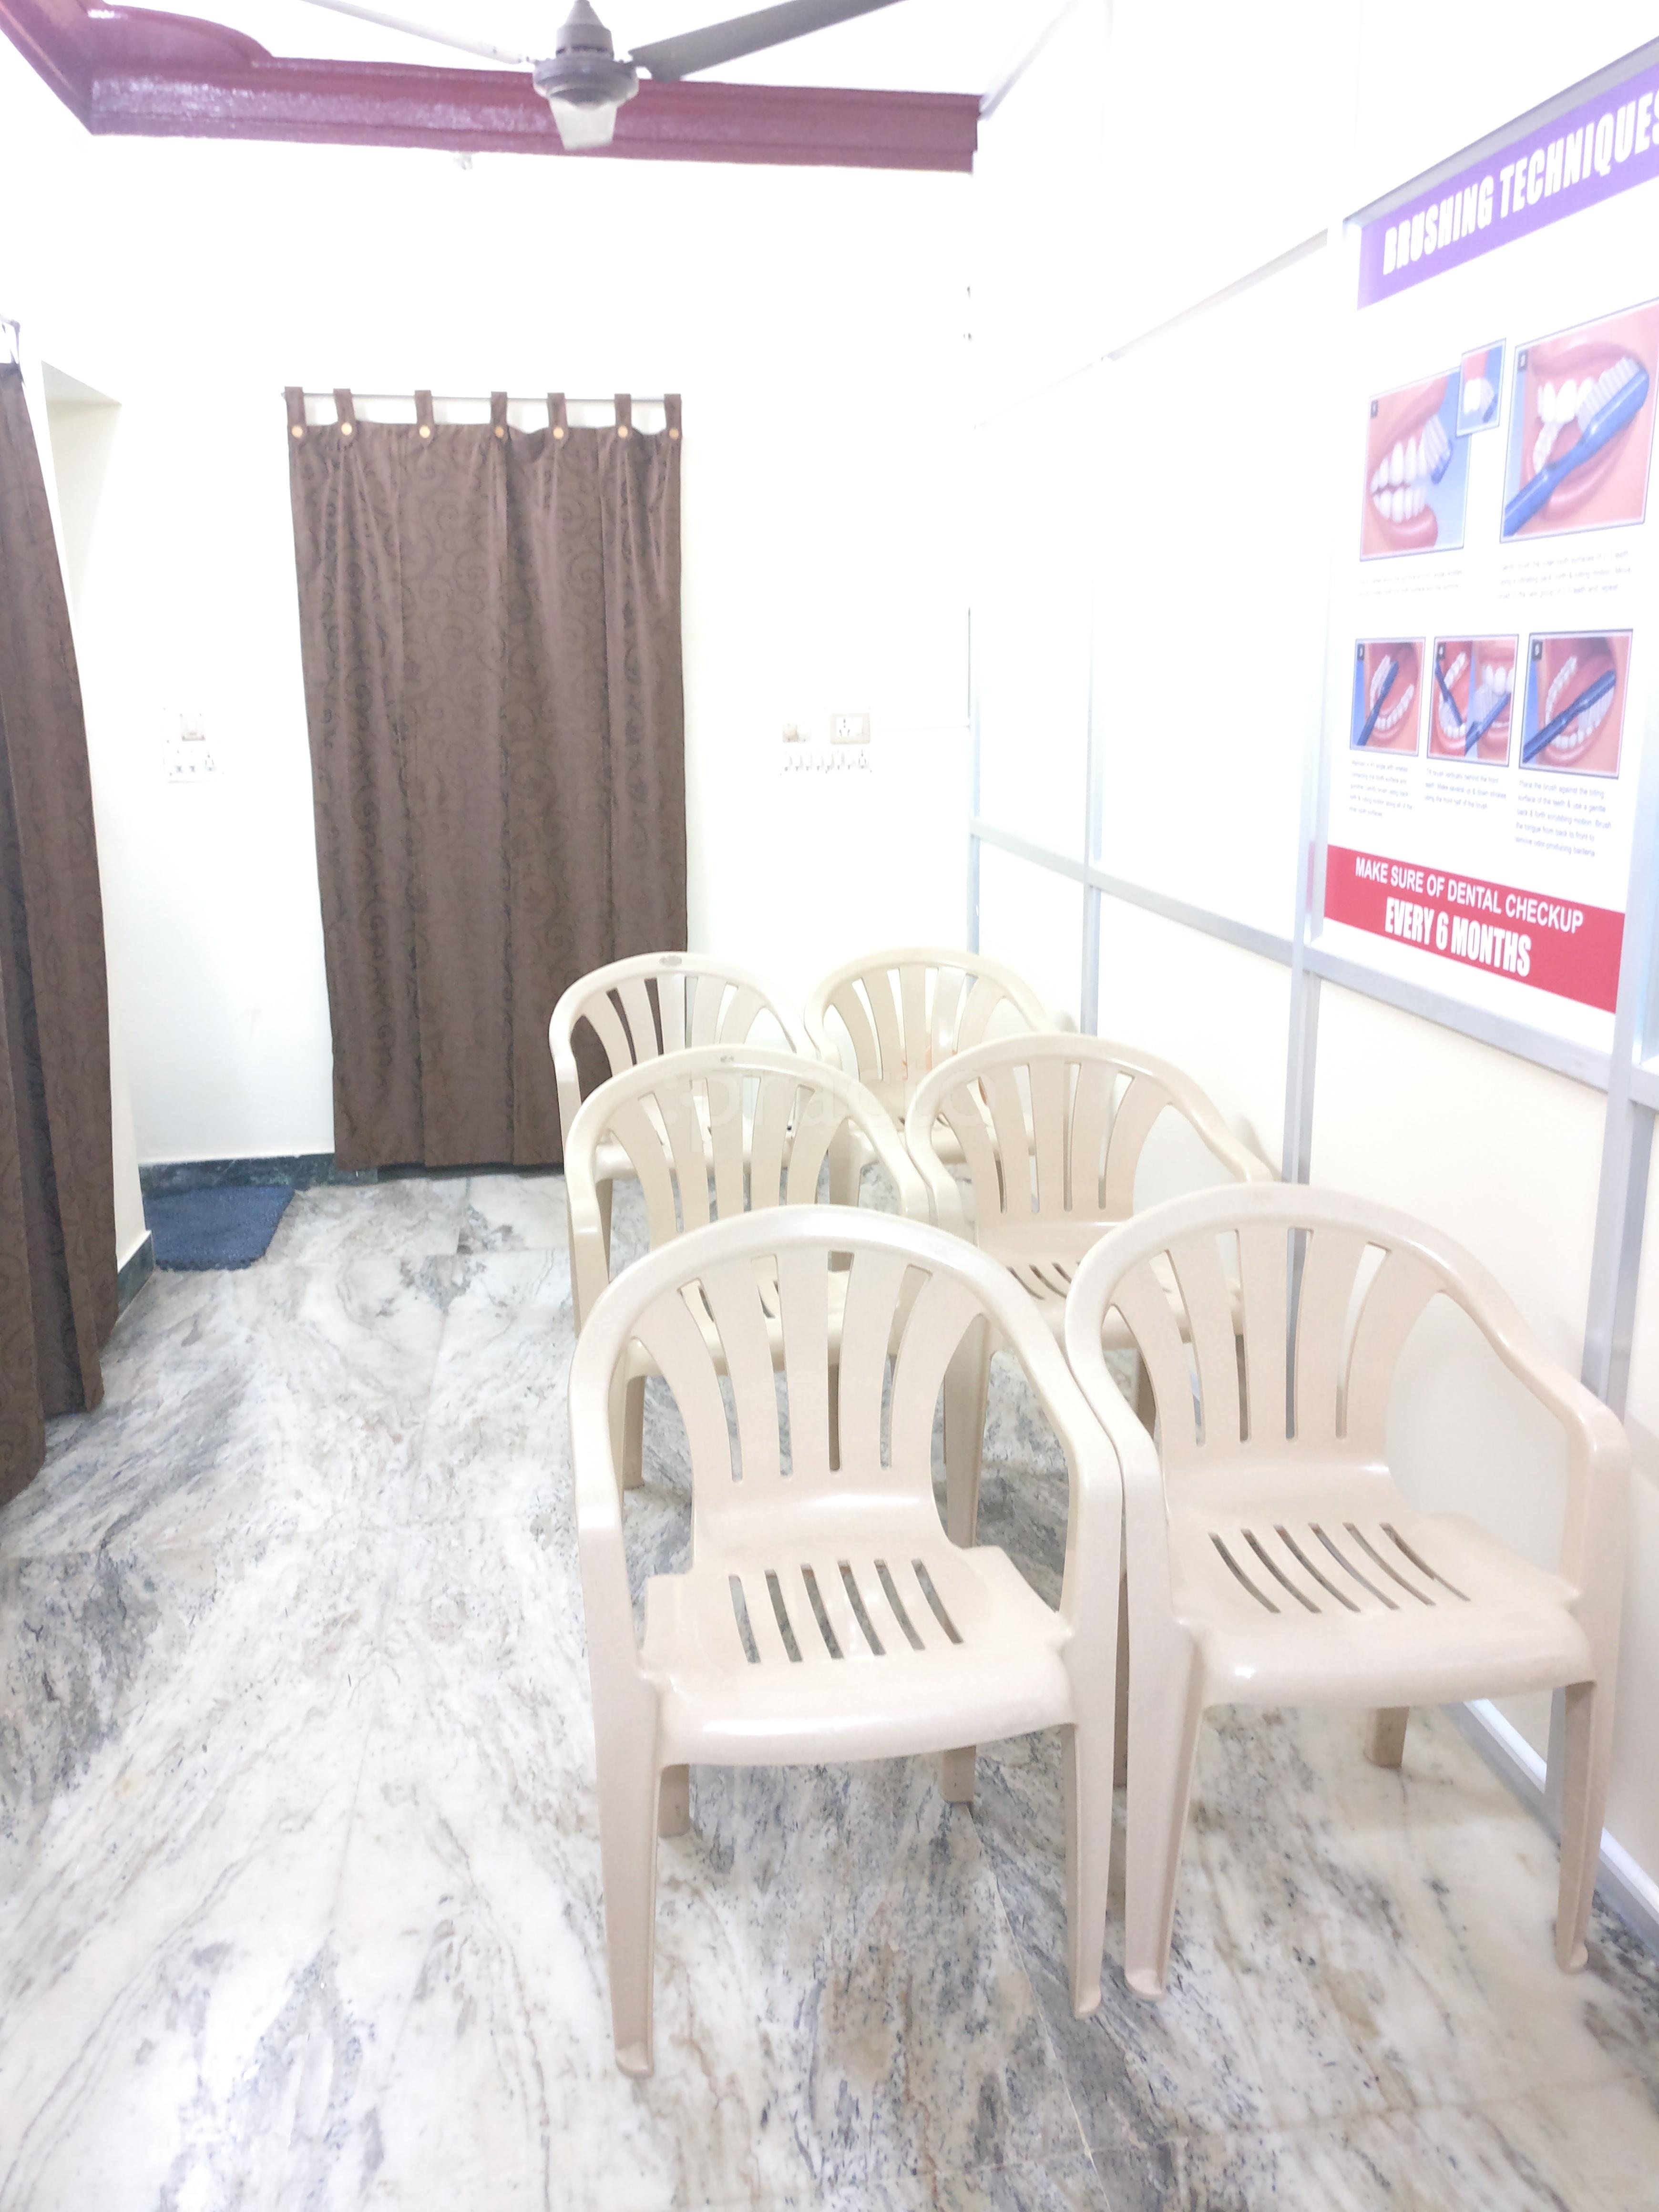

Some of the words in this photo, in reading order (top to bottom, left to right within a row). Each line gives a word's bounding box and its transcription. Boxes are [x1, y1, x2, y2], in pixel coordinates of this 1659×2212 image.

[1383, 175, 1494, 276] BRUSHING
[1355, 857, 1389, 883] MAKE
[1391, 865, 1424, 893] SURE
[1426, 874, 1445, 897] OF
[1447, 879, 1501, 914] DENTAL
[1505, 894, 1584, 934] CHECKUP
[1384, 896, 1434, 945] EVERY
[1435, 911, 1449, 950] 6
[1451, 916, 1531, 977] MONTHS
